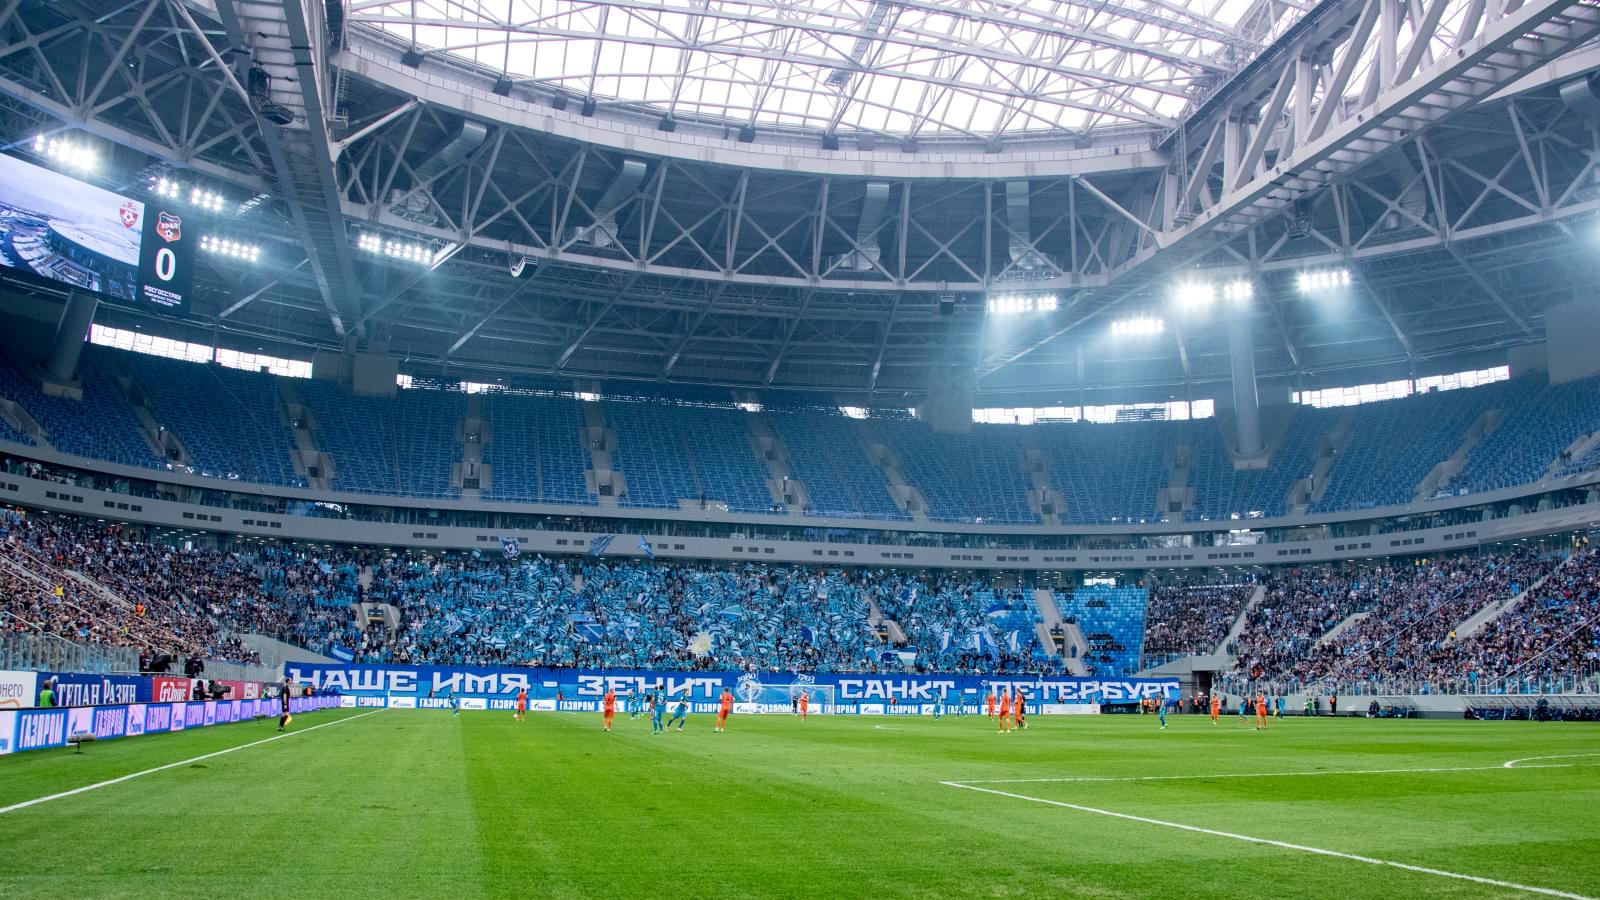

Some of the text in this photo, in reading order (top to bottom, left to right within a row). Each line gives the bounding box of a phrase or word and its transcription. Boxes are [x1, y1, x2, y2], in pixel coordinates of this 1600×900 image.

[156, 248, 175, 281] 0
[289, 668, 417, 691] НАШЕ
[433, 671, 531, 693] ИМЯ
[578, 675, 722, 697] ЗЕНИТ
[839, 680, 955, 699] САНКТ
[989, 681, 1179, 700] ПЕТЕРБУРГ
[420, 698, 452, 708] ГАЗПРО
[490, 700, 519, 709] ГАЗПРО
[560, 701, 594, 711] ГАЗПРОМ
[824, 704, 856, 714] ГАПРОМ
[887, 705, 918, 714] ГАЗПРОМ
[19, 713, 64, 748] ГАЗПРОМ
